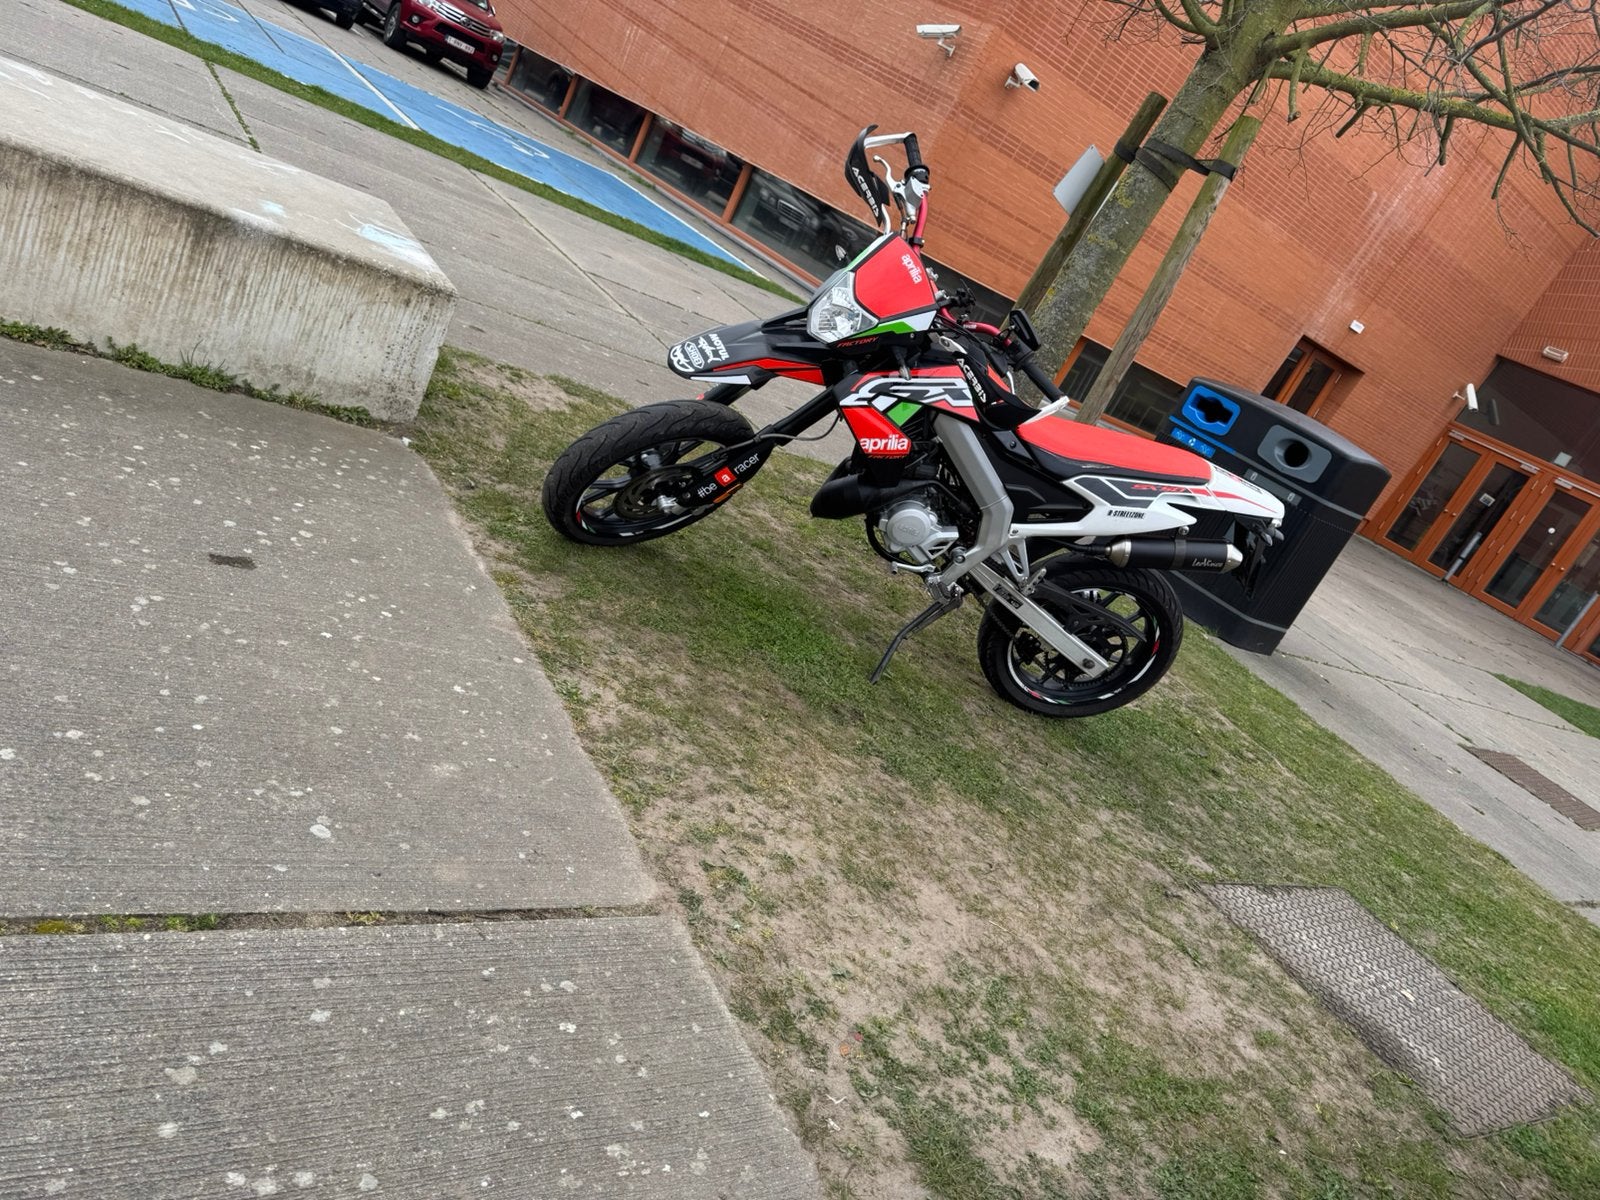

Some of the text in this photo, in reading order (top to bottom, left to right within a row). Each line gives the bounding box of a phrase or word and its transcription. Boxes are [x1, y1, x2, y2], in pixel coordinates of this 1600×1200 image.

[851, 166, 879, 217] ACERBIS
[901, 253, 923, 285] aprilia
[708, 333, 730, 361] MOTUL
[837, 336, 880, 348] FACTORY
[956, 358, 987, 403] ACERBIS
[860, 434, 909, 453] aprilia
[697, 482, 718, 498] #be
[733, 453, 760, 475] racer
